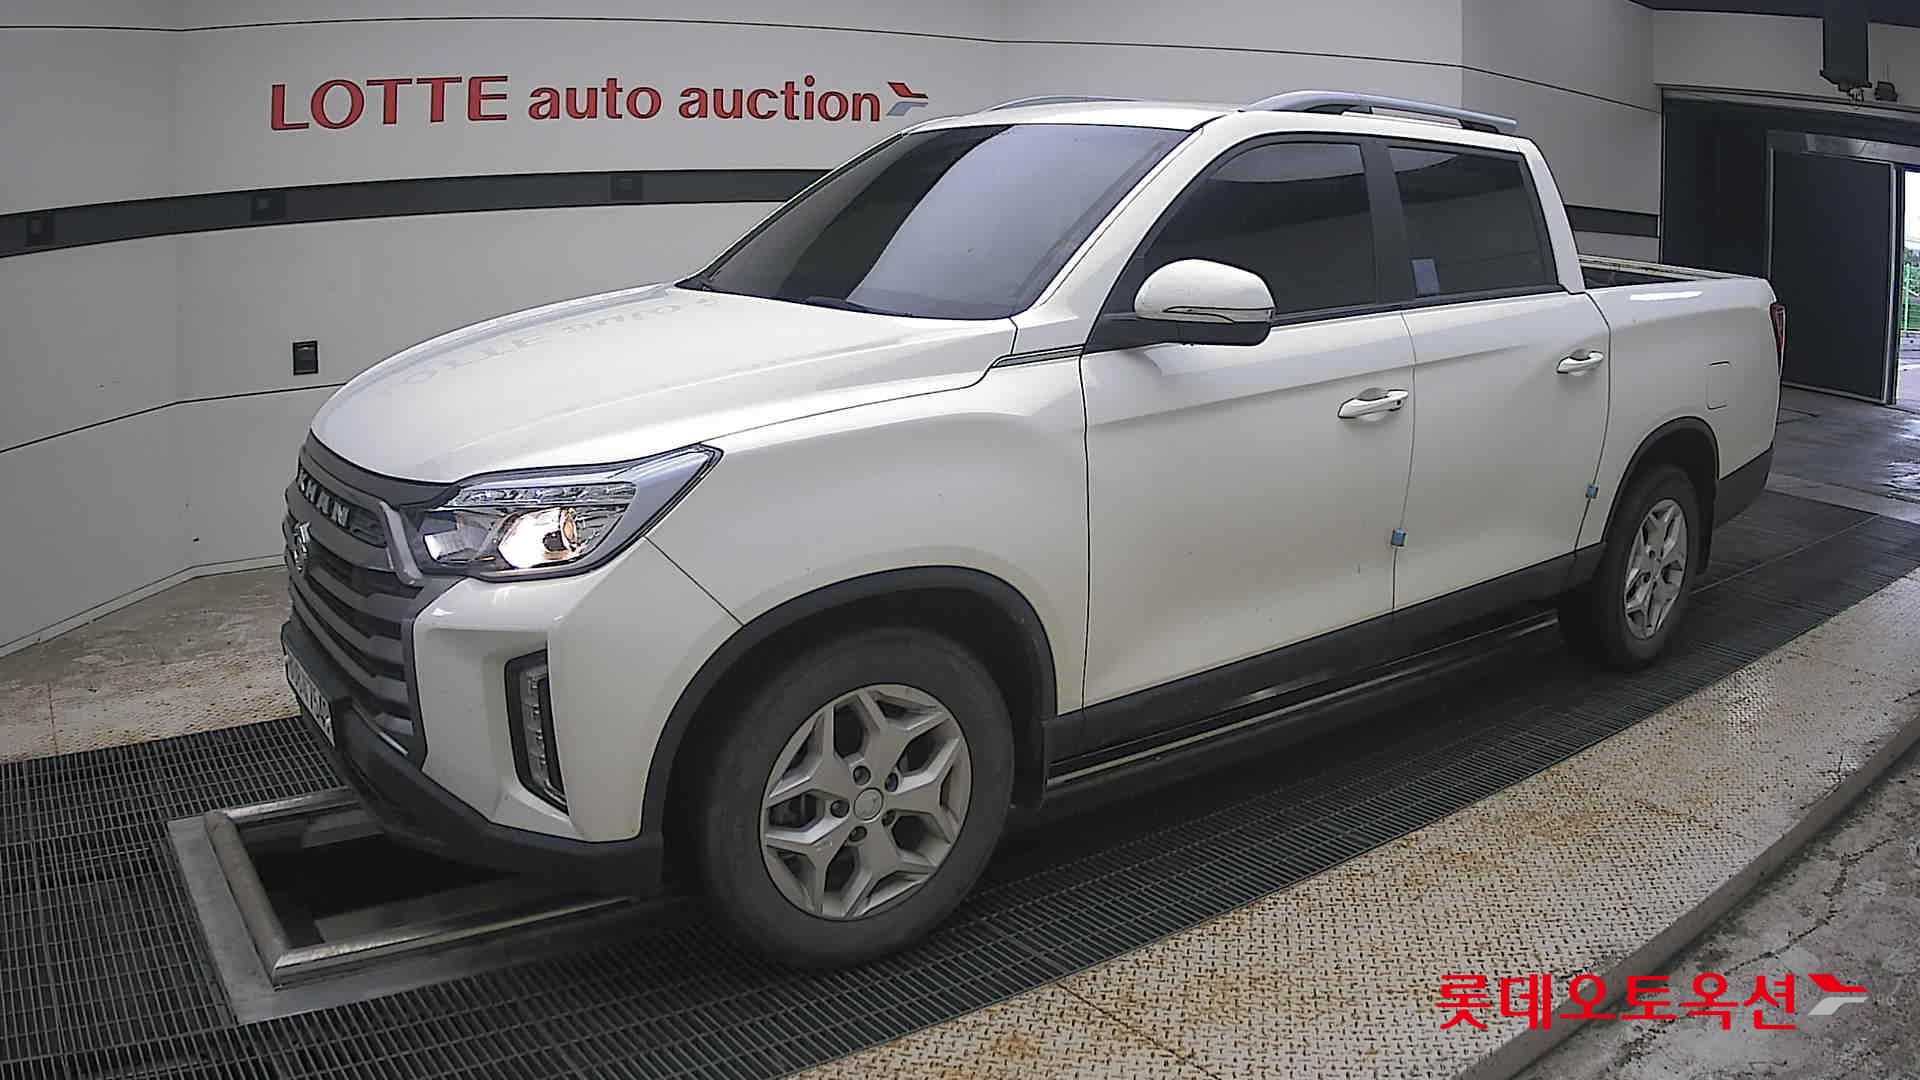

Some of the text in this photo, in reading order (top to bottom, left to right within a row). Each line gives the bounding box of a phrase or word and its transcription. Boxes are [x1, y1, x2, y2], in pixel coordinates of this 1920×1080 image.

[271, 75, 881, 131] LOTTE auto auction
